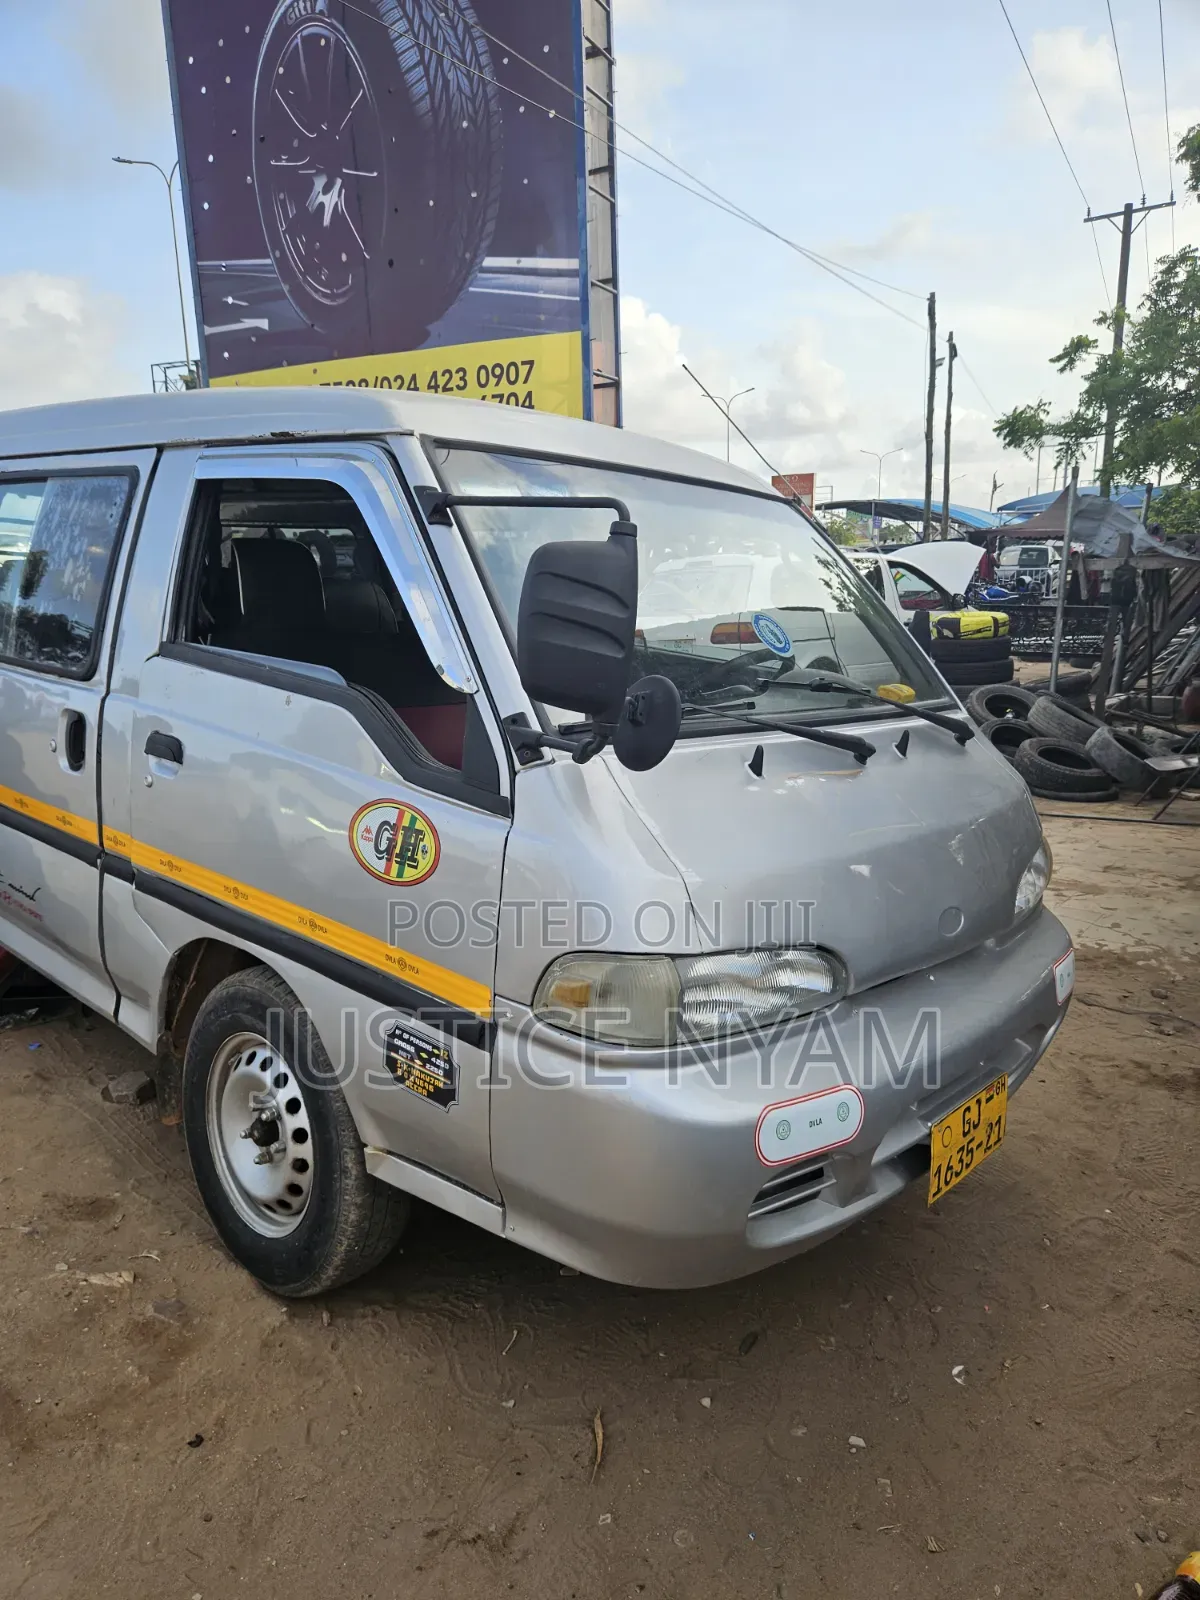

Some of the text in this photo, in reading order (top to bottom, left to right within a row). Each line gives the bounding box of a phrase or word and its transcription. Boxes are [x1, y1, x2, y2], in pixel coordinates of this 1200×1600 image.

[427, 367, 468, 394] 423
[476, 360, 535, 389] 0907
[962, 1076, 1006, 1138] GJ GH
[932, 1115, 1002, 1198] 1635-21
